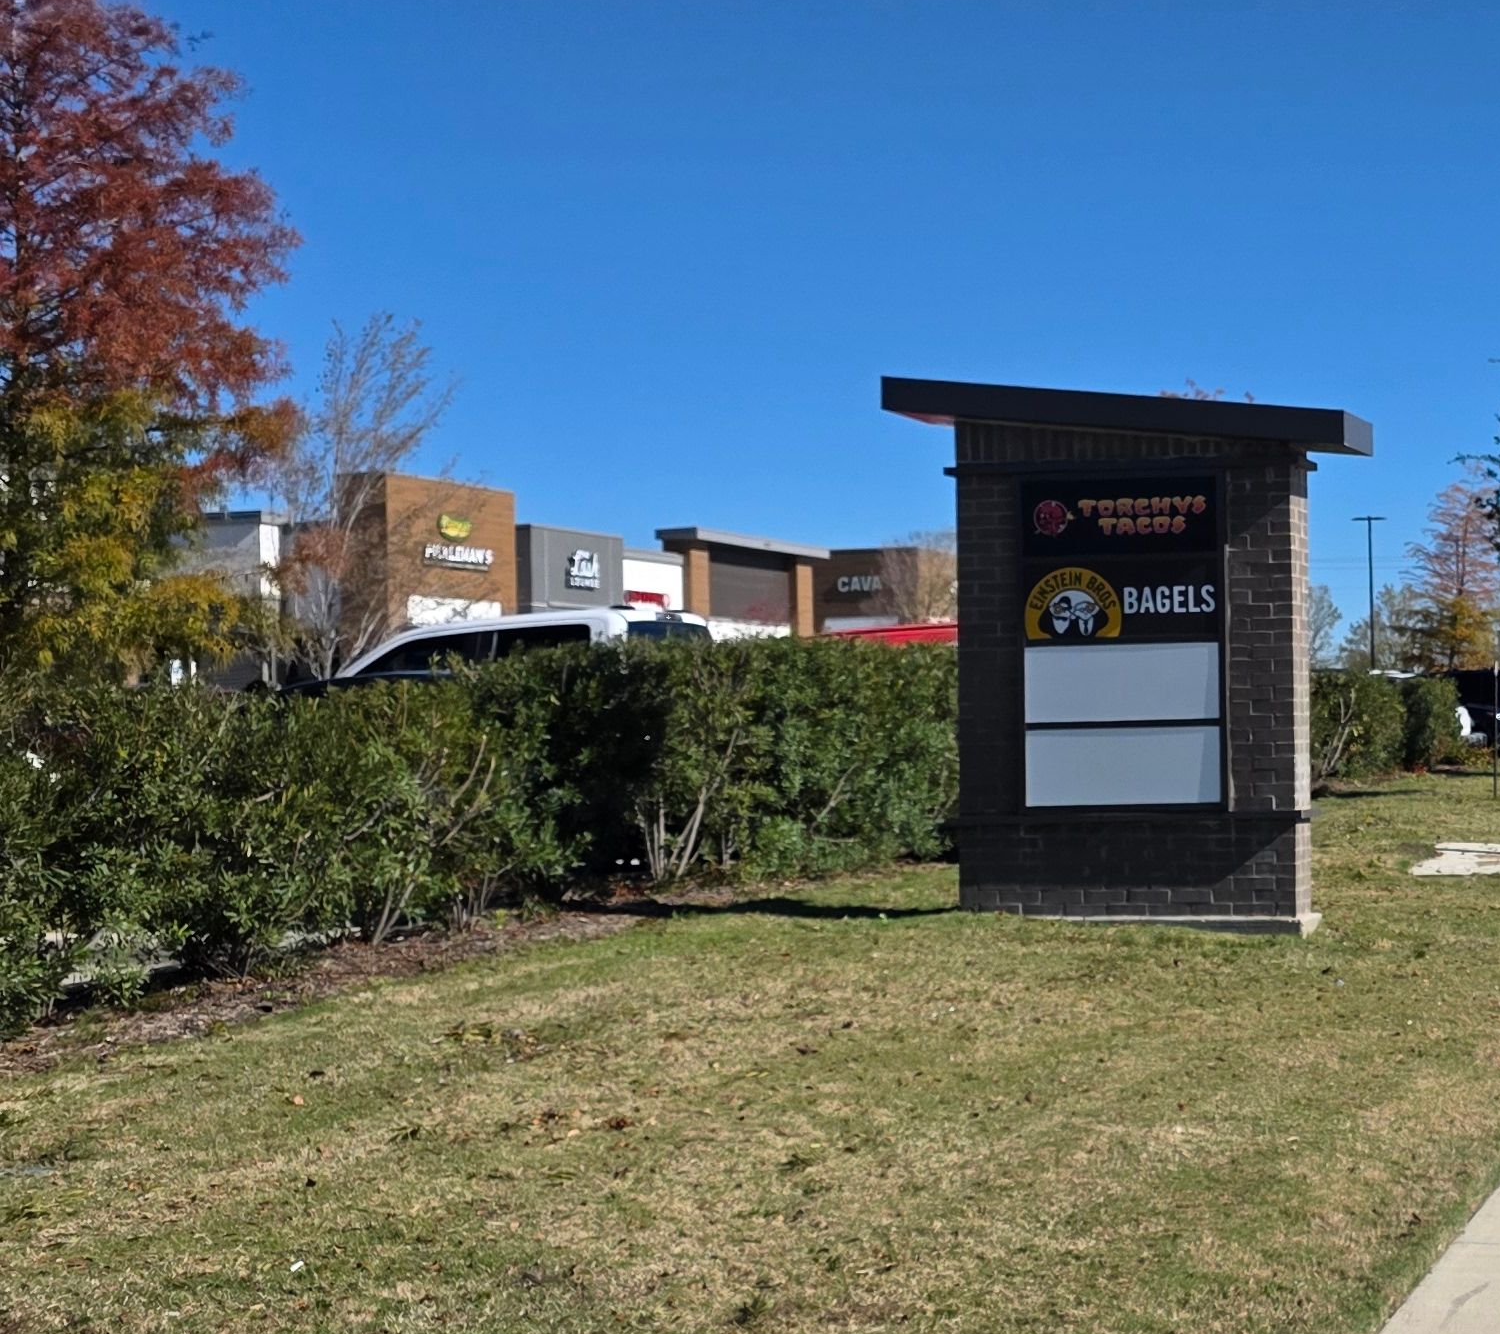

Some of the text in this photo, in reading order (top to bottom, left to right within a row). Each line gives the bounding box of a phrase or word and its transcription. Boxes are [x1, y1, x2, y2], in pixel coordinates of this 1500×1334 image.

[1077, 495, 1207, 517] TORCHYS
[1098, 516, 1187, 536] TACOS
[837, 576, 882, 593] CAVA
[1029, 570, 1117, 612] EINSTEIN BROS
[1123, 584, 1216, 614] BAGELS
